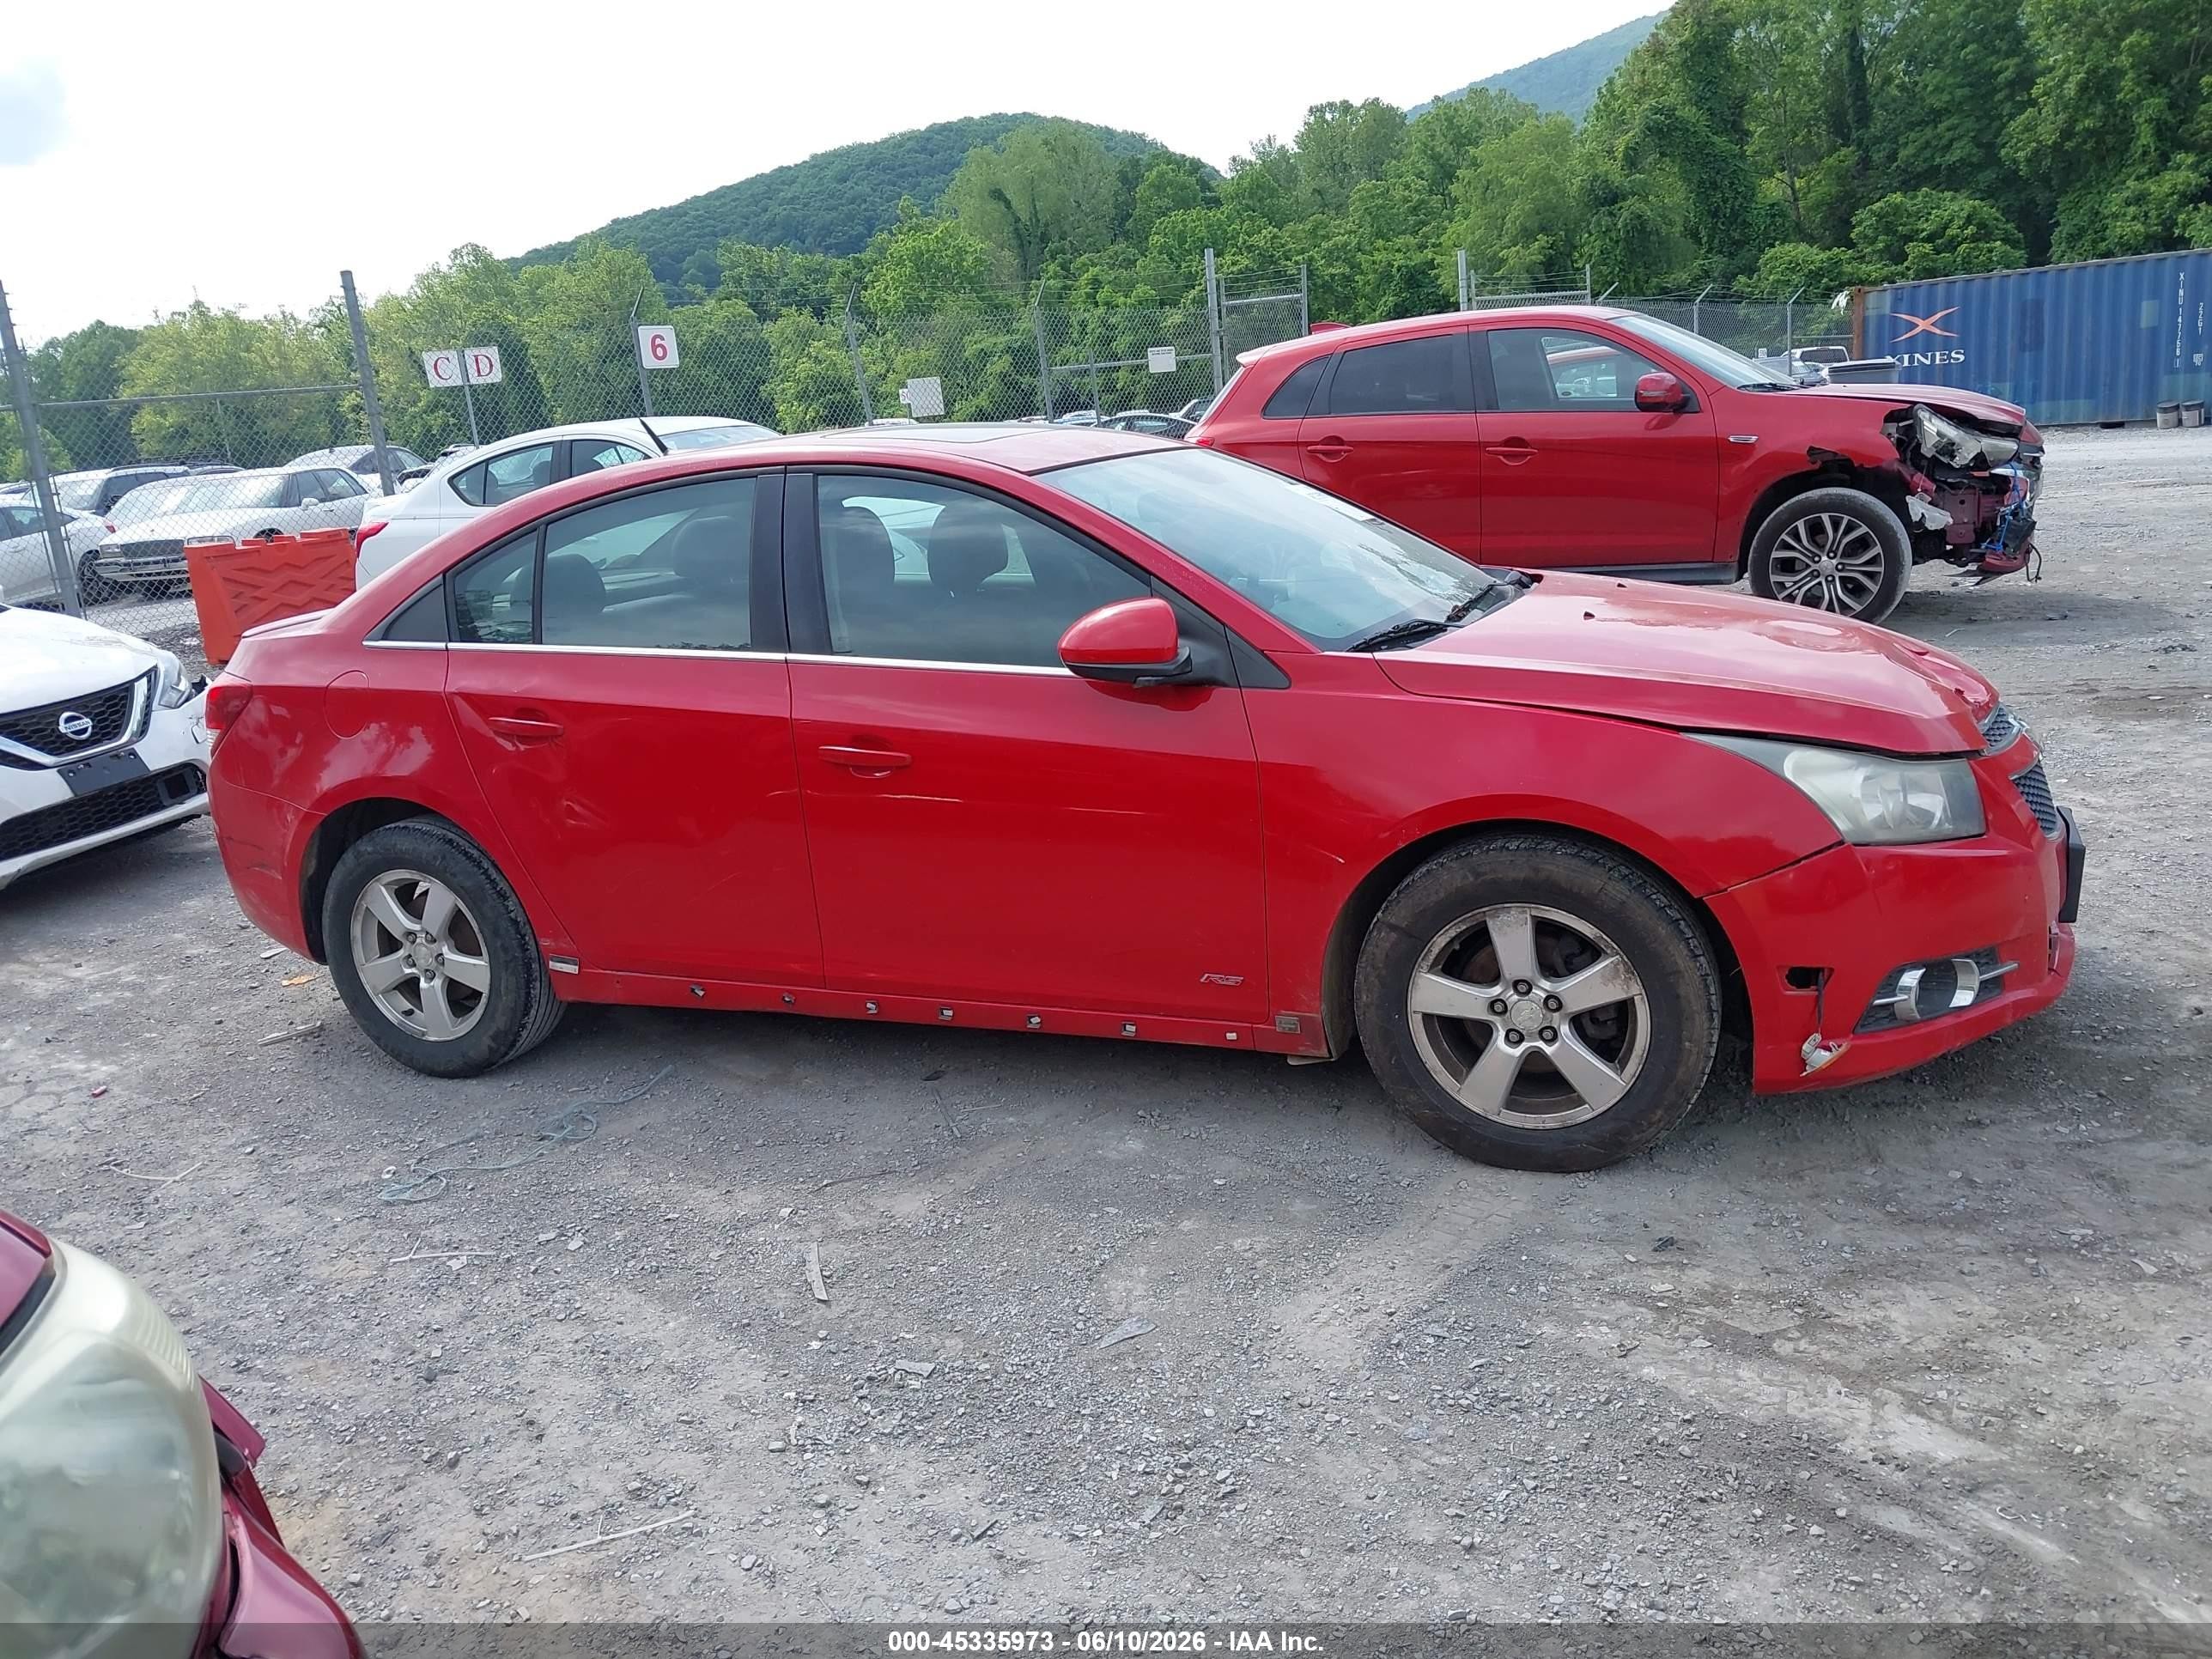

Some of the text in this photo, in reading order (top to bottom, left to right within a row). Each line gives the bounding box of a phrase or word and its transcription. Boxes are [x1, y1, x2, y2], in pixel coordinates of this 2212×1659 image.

[650, 333, 668, 362] 6
[433, 356, 453, 381] C
[471, 354, 494, 378] D
[64, 720, 91, 731] NISSAN
[1200, 973, 1244, 987] RS
